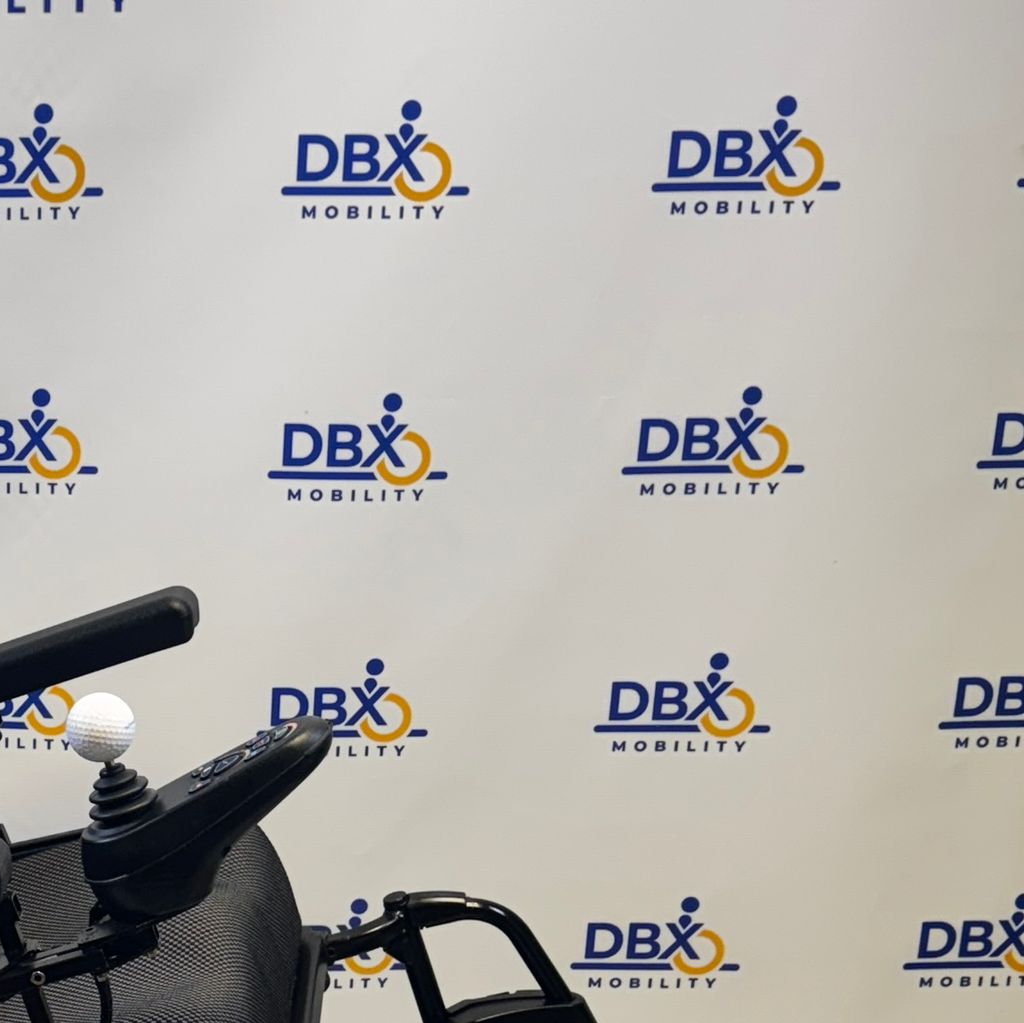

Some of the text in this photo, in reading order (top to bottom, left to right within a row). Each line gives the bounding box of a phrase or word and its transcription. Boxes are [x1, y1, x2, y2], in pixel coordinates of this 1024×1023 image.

[297, 134, 427, 182] DBX
[668, 130, 801, 178] DBX
[302, 206, 443, 219] MOBILITY
[671, 201, 814, 215] MOBILITY
[283, 424, 408, 467] DBX
[637, 417, 766, 462] DBX
[288, 489, 423, 501] MOBILITY
[640, 483, 779, 496] MOBILITY
[609, 681, 733, 721] DBX
[953, 676, 1024, 718] DB
[271, 687, 390, 726] DBX
[612, 741, 745, 752] MOBILITY
[955, 736, 1021, 748] MOBI
[336, 745, 405, 757] ILITY
[585, 923, 703, 959] DBX
[917, 920, 1024, 959] DBX
[334, 978, 388, 988] LITY
[588, 978, 716, 988] MOBILITY
[919, 976, 1024, 987] MOBILIT
